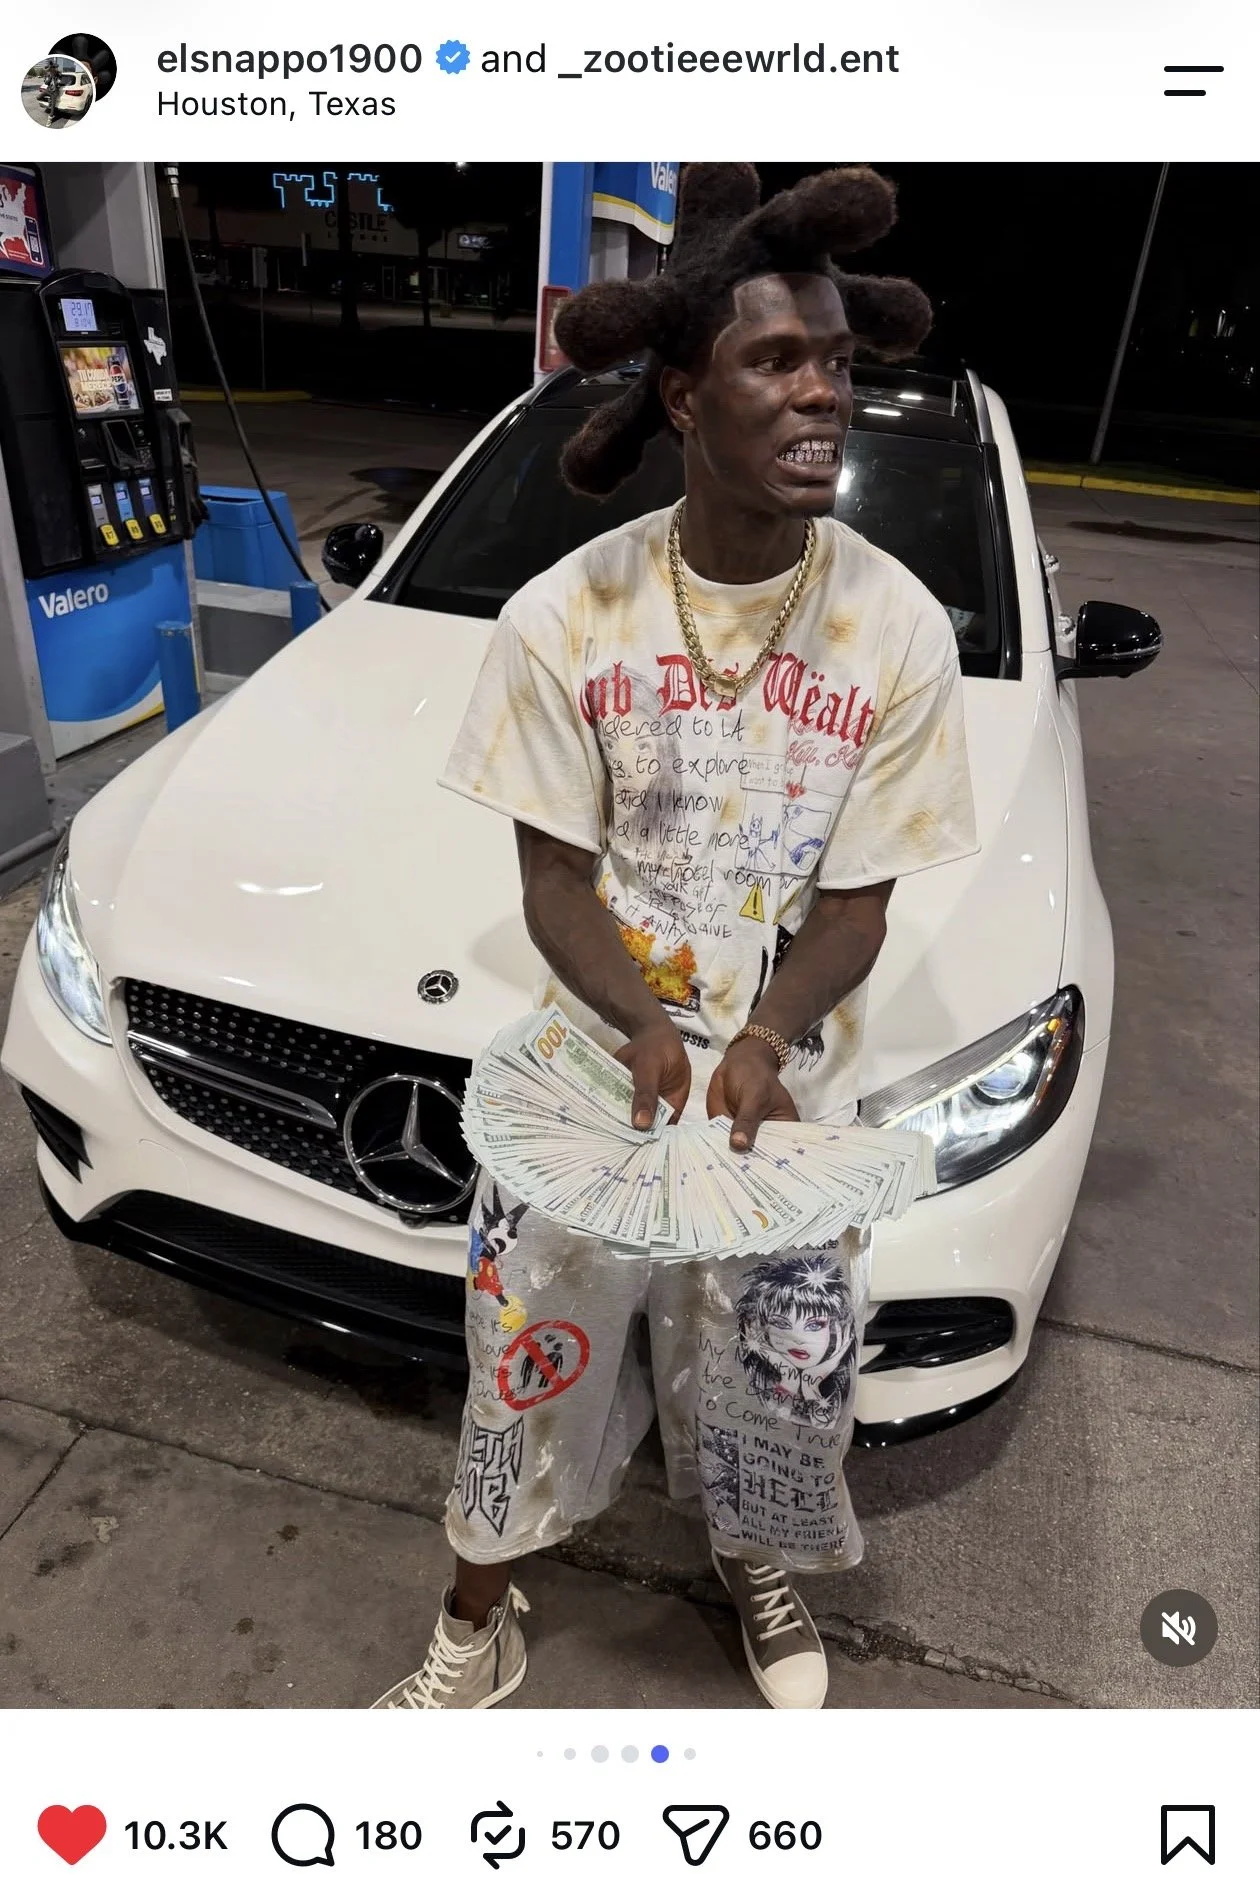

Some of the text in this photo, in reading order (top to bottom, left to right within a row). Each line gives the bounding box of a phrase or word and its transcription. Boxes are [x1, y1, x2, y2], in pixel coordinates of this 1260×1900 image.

[324, 210, 389, 232] CSTLE
[38, 583, 110, 620] Valero
[635, 755, 662, 776] to
[672, 751, 751, 783] explore
[614, 788, 648, 811] did
[672, 790, 726, 814] know
[659, 819, 703, 847] little
[707, 831, 751, 851] more
[722, 868, 772, 897] room
[537, 1019, 568, 1060] 100
[725, 1401, 781, 1431] Come
[791, 1420, 841, 1449] True
[754, 1436, 793, 1460] MAY
[800, 1452, 825, 1470] BE
[743, 1451, 836, 1488] GOING TO
[742, 1468, 839, 1513] HELL
[742, 1499, 836, 1527] BUT AT LEAST
[742, 1514, 766, 1532] ALL
[741, 1529, 775, 1548] WILL
